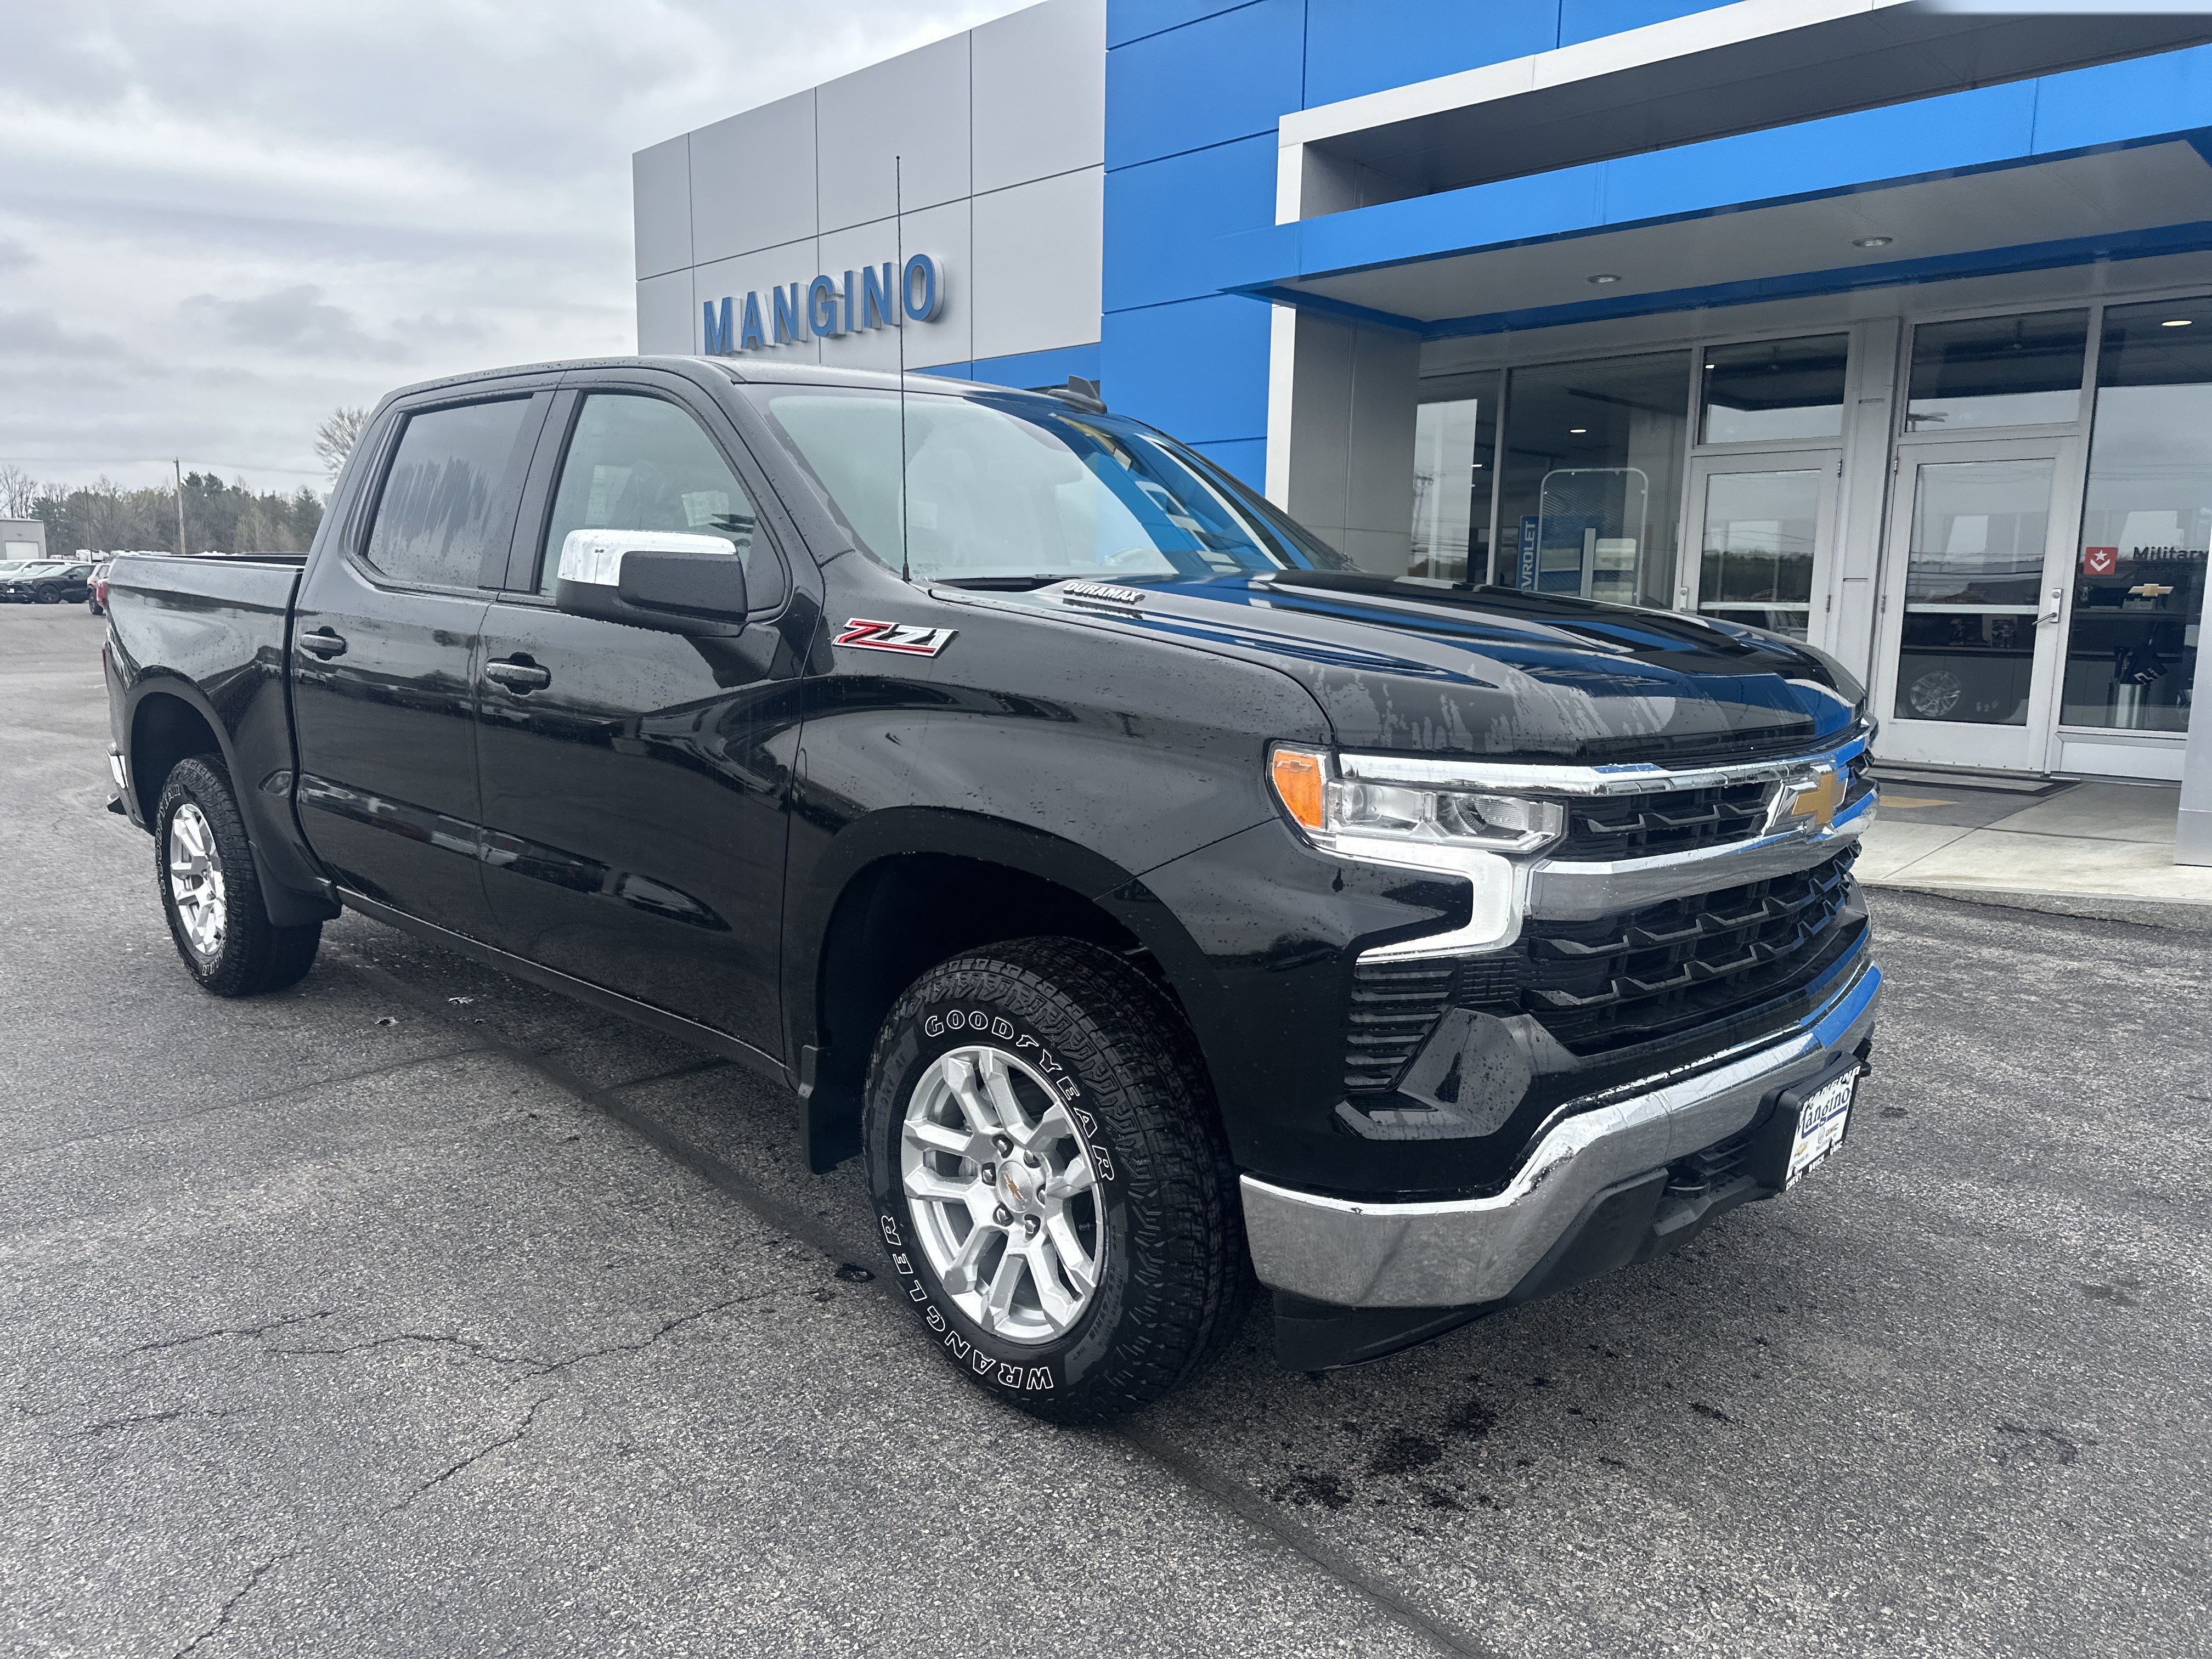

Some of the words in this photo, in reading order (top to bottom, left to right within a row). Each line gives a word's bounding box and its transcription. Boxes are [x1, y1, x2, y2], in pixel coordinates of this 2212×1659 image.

[704, 253, 944, 356] MANGINO
[1521, 521, 1536, 590] VROLET
[2133, 546, 2209, 561] Military
[1063, 582, 1145, 604] DURAMAX
[831, 617, 959, 658] Z71
[925, 1009, 1114, 1181] GOODYEAR
[1808, 1154, 1825, 1173] BUICK
[1829, 1141, 1843, 1155] GMC
[881, 1215, 1053, 1390] WRANGLER
